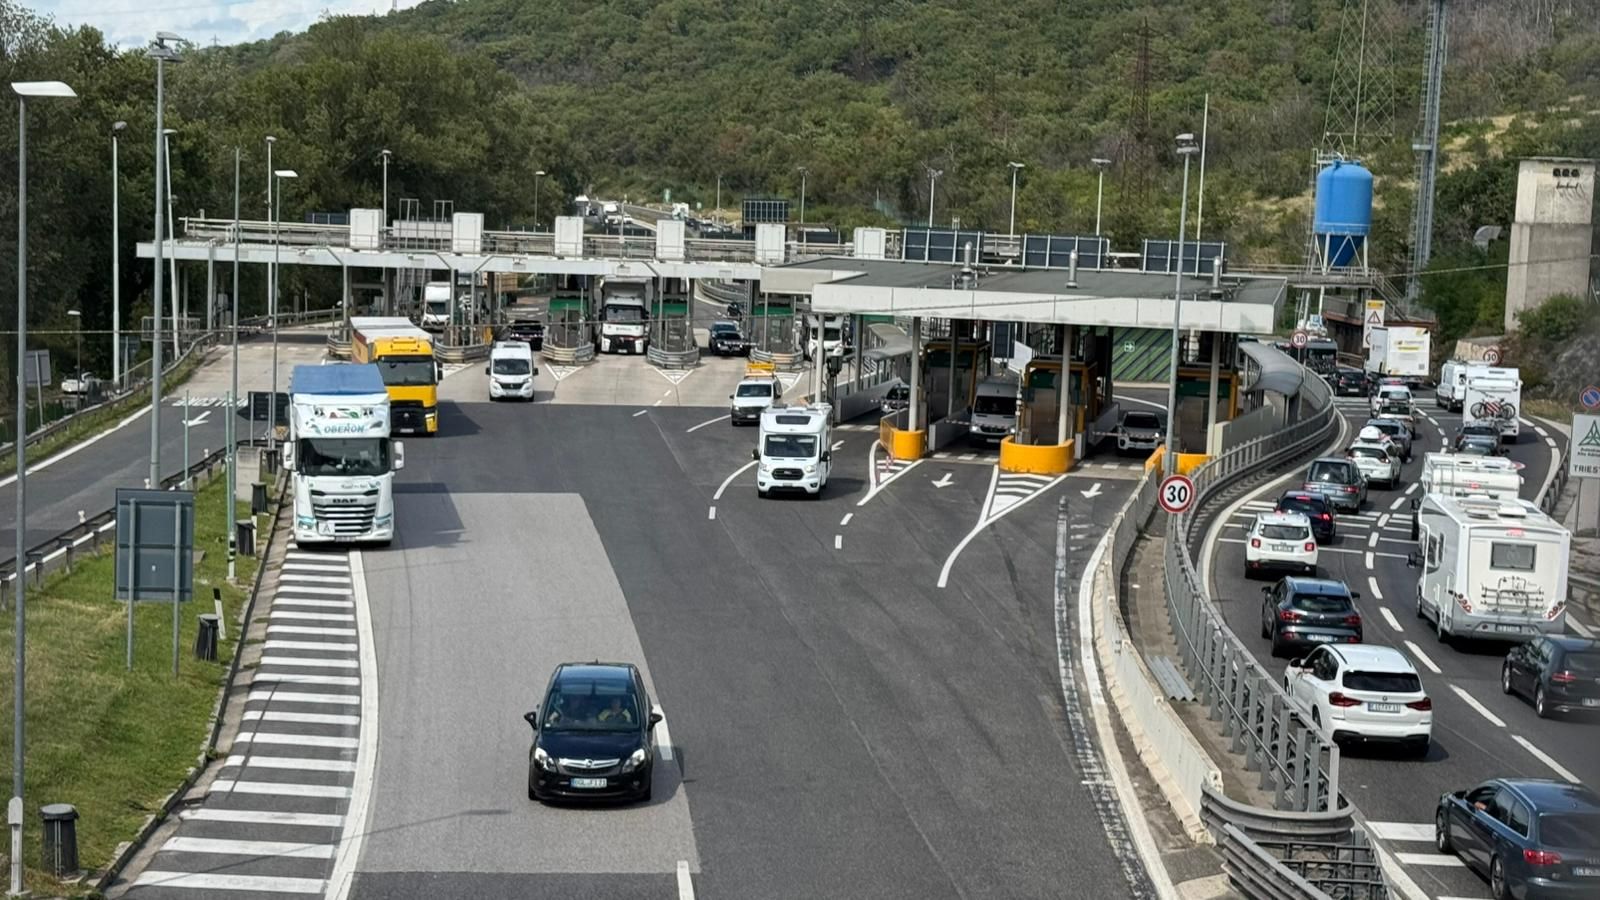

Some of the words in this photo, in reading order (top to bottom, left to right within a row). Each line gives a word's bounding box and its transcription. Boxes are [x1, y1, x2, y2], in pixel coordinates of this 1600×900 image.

[1295, 335, 1305, 343] 30
[324, 424, 365, 433] OBERON
[1573, 464, 1600, 473] TRIES
[1167, 485, 1188, 503] 30
